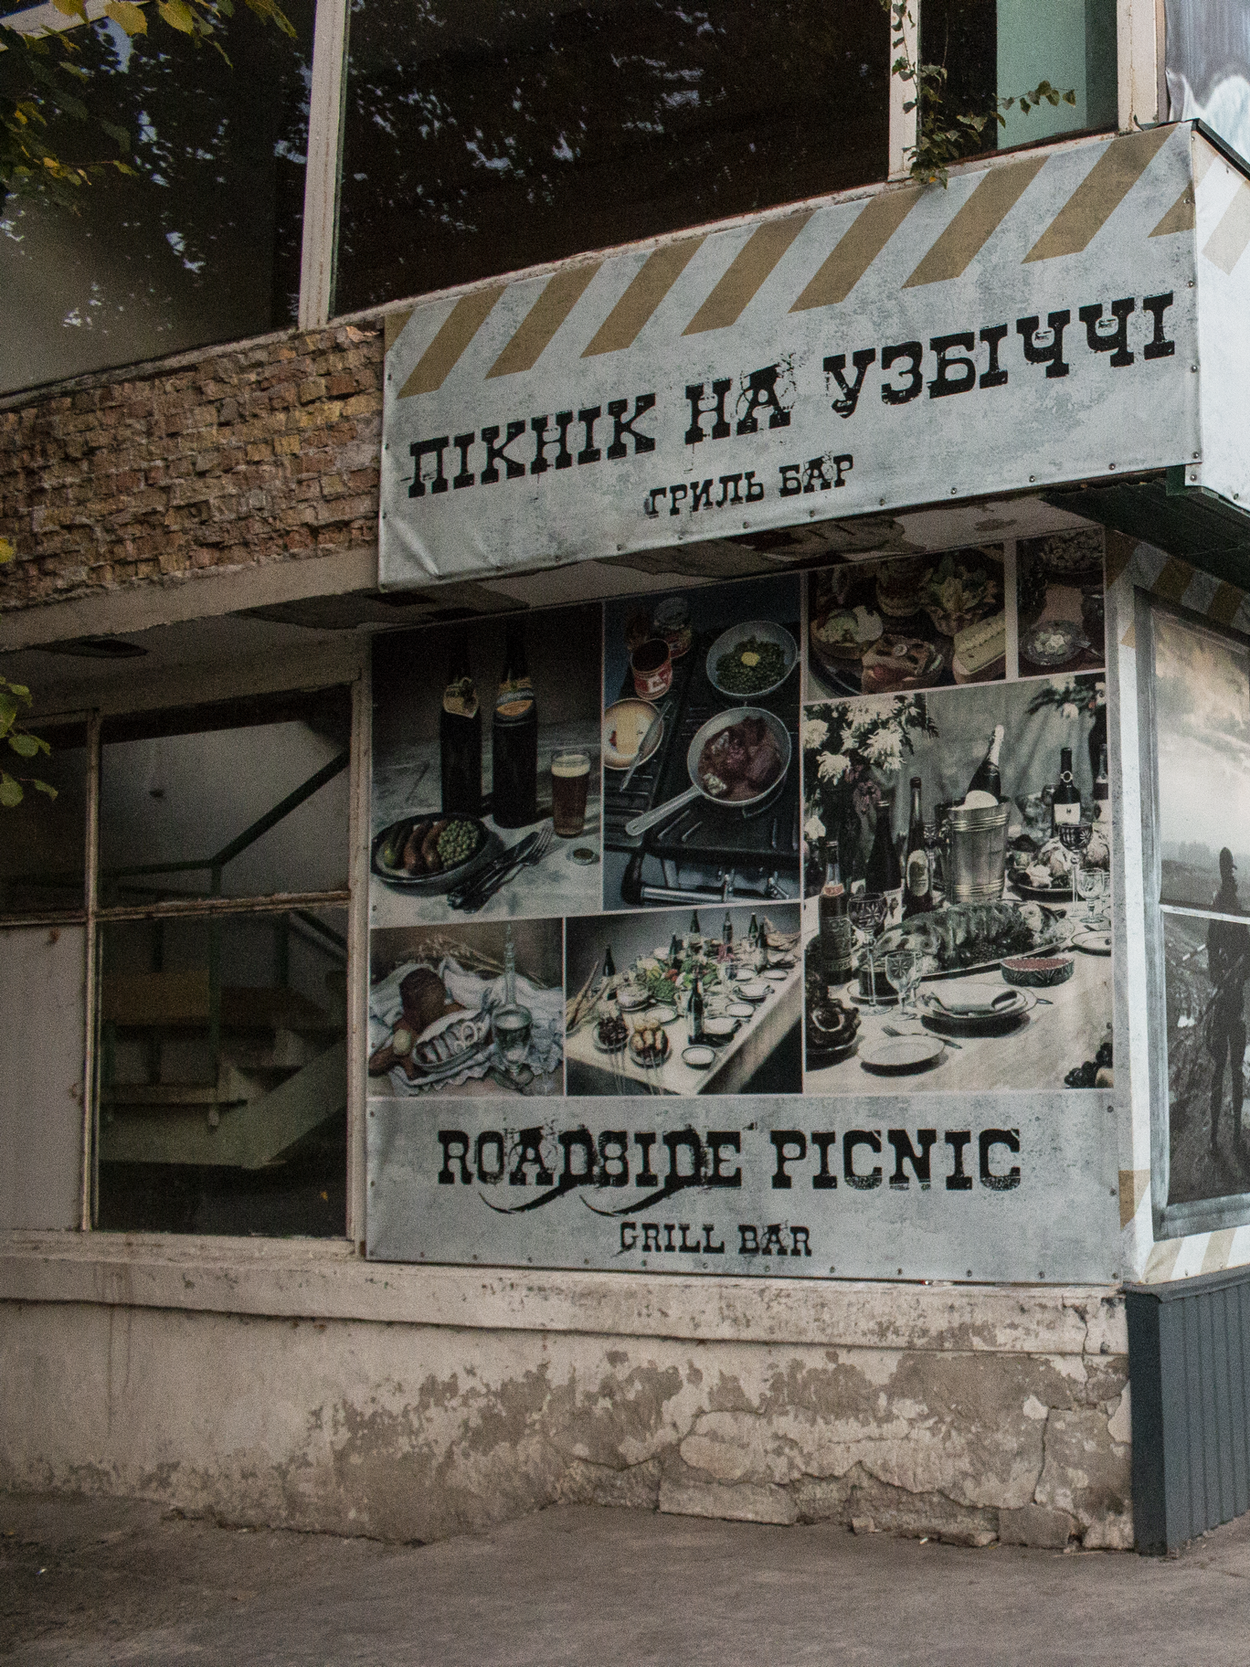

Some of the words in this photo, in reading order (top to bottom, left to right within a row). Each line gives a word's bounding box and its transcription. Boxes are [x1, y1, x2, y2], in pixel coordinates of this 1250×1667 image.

[408, 392, 656, 498] ПІКНІК
[684, 360, 793, 445] НА
[823, 290, 1175, 418] УЗБІЧЧІ
[647, 471, 764, 517] ГРИЛЬ
[779, 453, 854, 497] БАР
[437, 1125, 742, 1216] ROADSIDE
[770, 1128, 1021, 1191] PICNIC
[613, 1221, 725, 1255] GRILL
[738, 1221, 812, 1257] BAR
